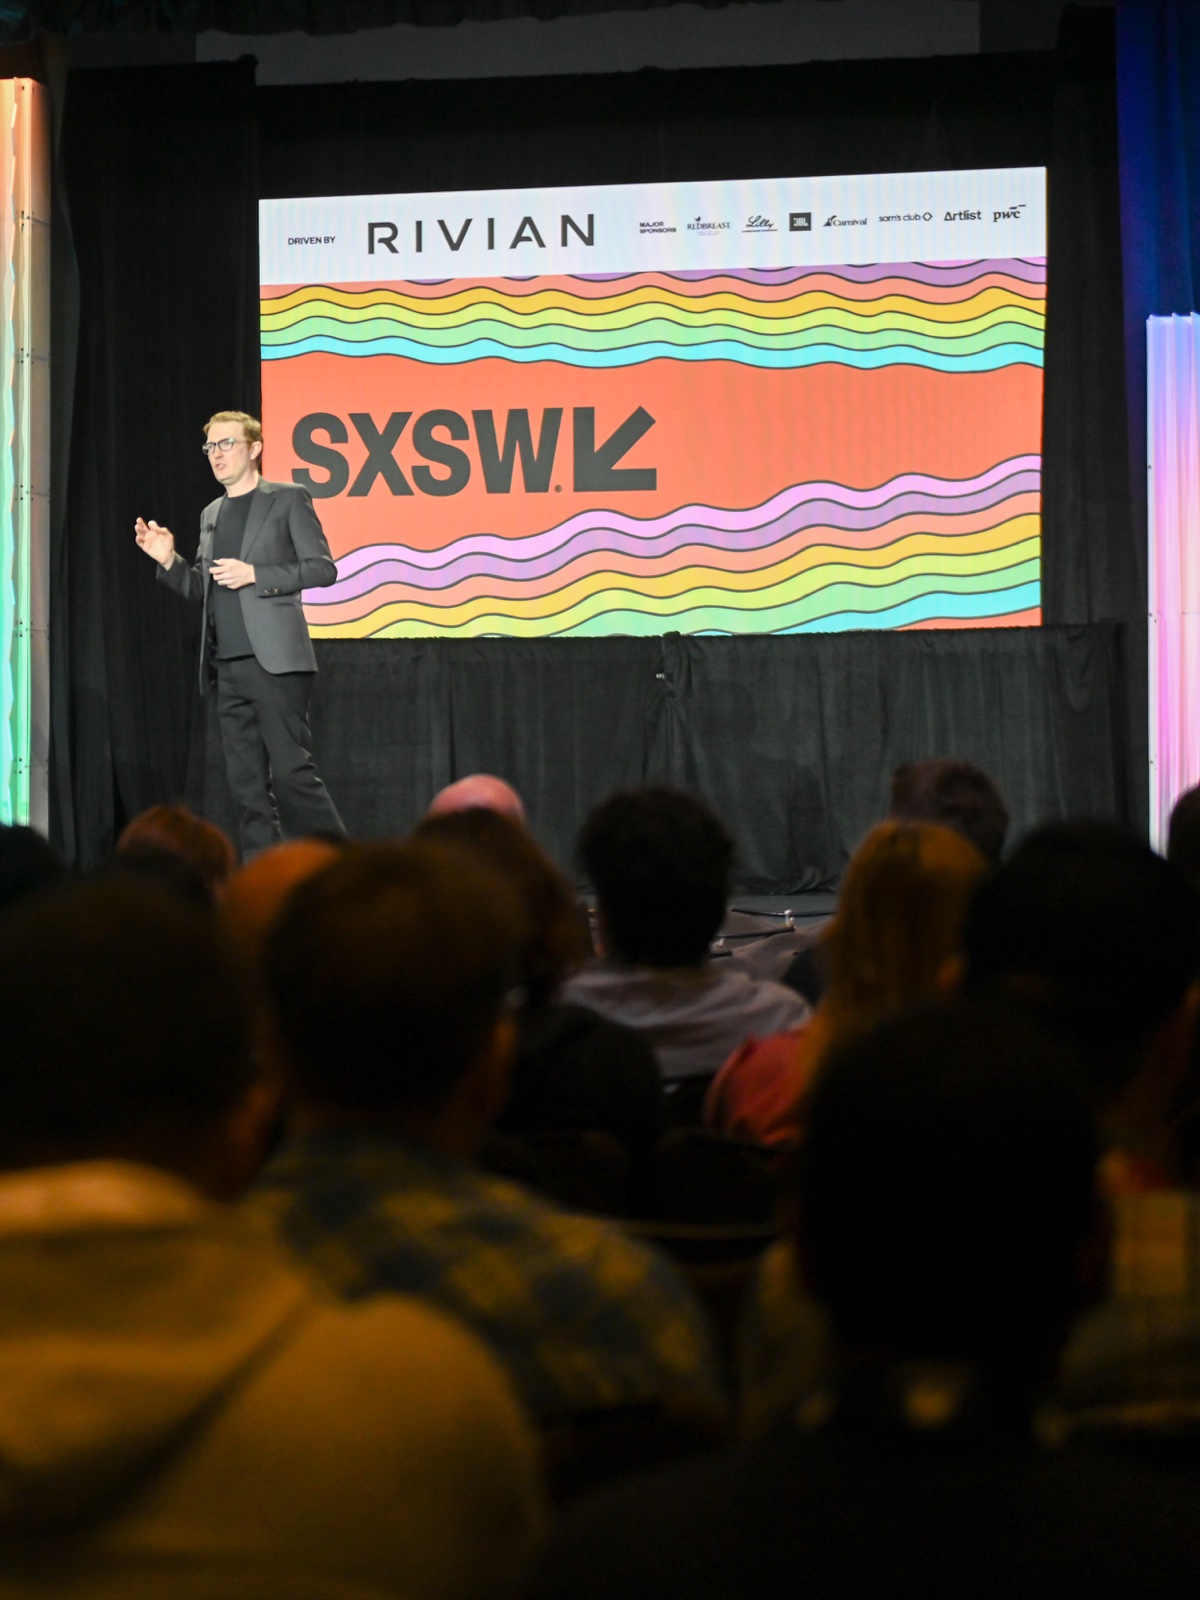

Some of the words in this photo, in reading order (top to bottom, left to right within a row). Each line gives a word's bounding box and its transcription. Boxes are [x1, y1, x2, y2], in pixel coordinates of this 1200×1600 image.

[878, 214, 901, 222] sam's
[902, 212, 921, 221] club
[992, 209, 1021, 223] pwc
[686, 221, 731, 230] REDBREAST
[745, 215, 775, 228] Lilly
[793, 217, 809, 227] JBL
[832, 217, 868, 227] Carnival
[367, 213, 595, 255] RIVIAN
[287, 237, 322, 246] DRIVEN
[324, 236, 336, 244] BY
